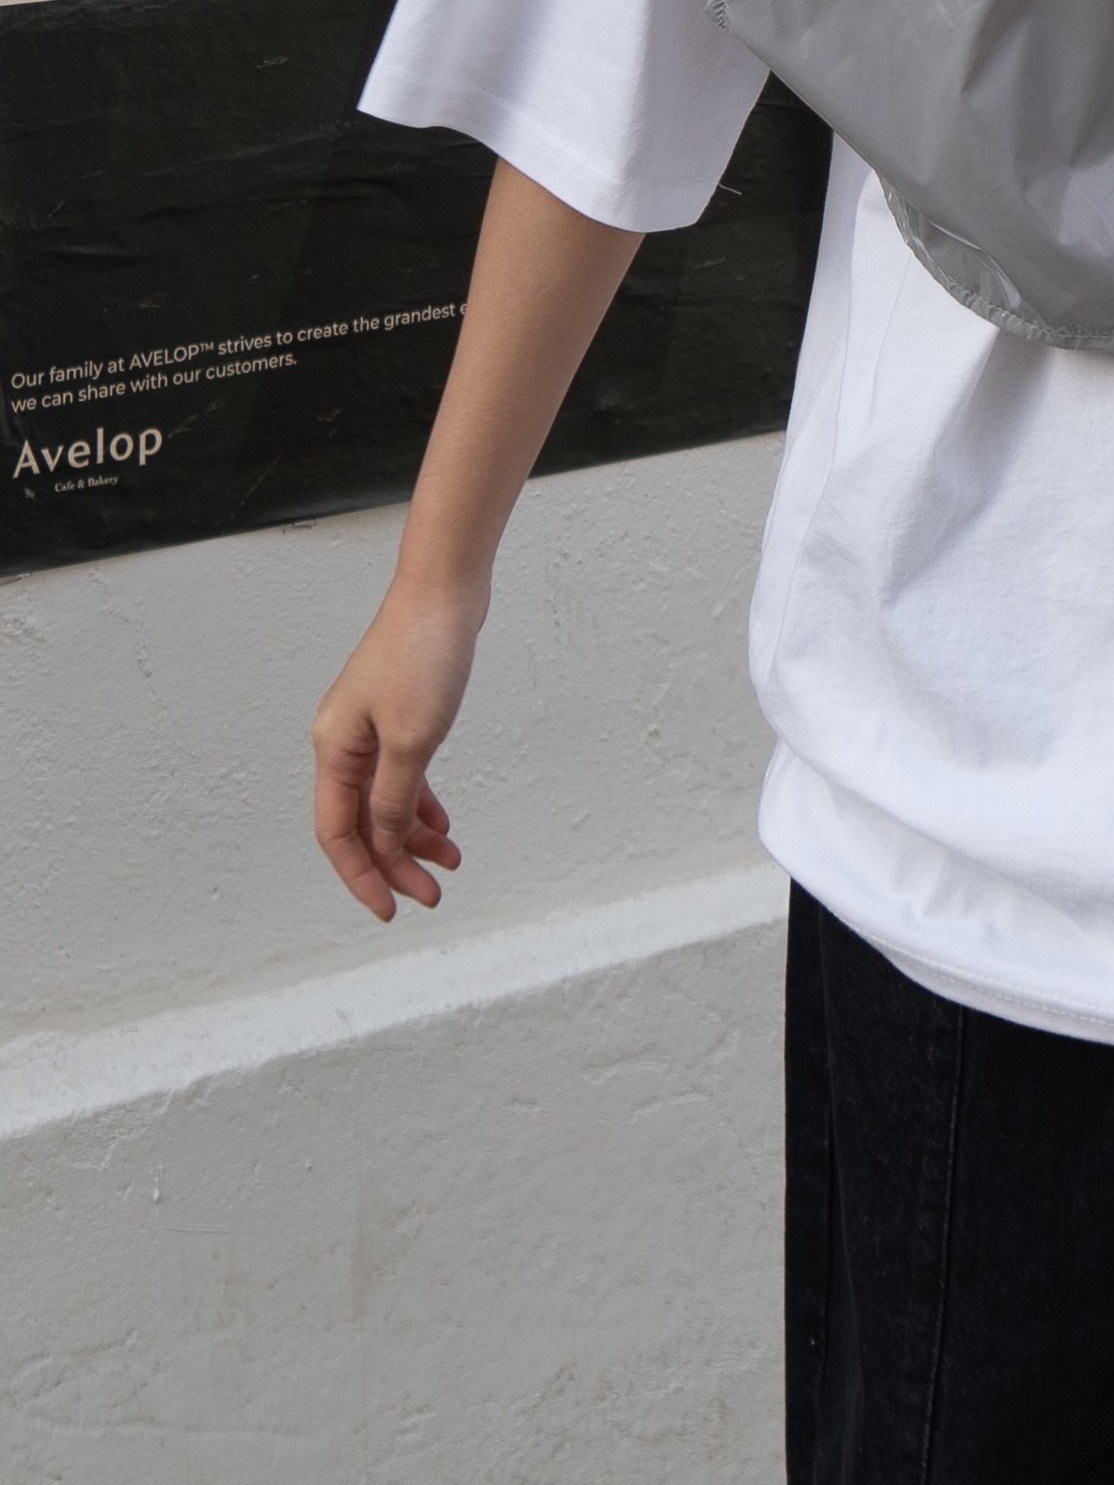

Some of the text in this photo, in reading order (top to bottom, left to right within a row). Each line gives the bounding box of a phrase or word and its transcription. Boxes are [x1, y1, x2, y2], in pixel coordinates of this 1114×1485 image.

[12, 373, 44, 388] Our
[50, 361, 103, 382] family
[108, 358, 124, 373] at
[219, 336, 271, 354] strives
[276, 332, 293, 344] to
[298, 323, 348, 341] create
[353, 317, 379, 332] the
[384, 304, 455, 330] grandest
[12, 352, 297, 412] we can share with our customers.
[13, 427, 163, 478] Avelop
[55, 476, 120, 493] Cafe & Bakery
